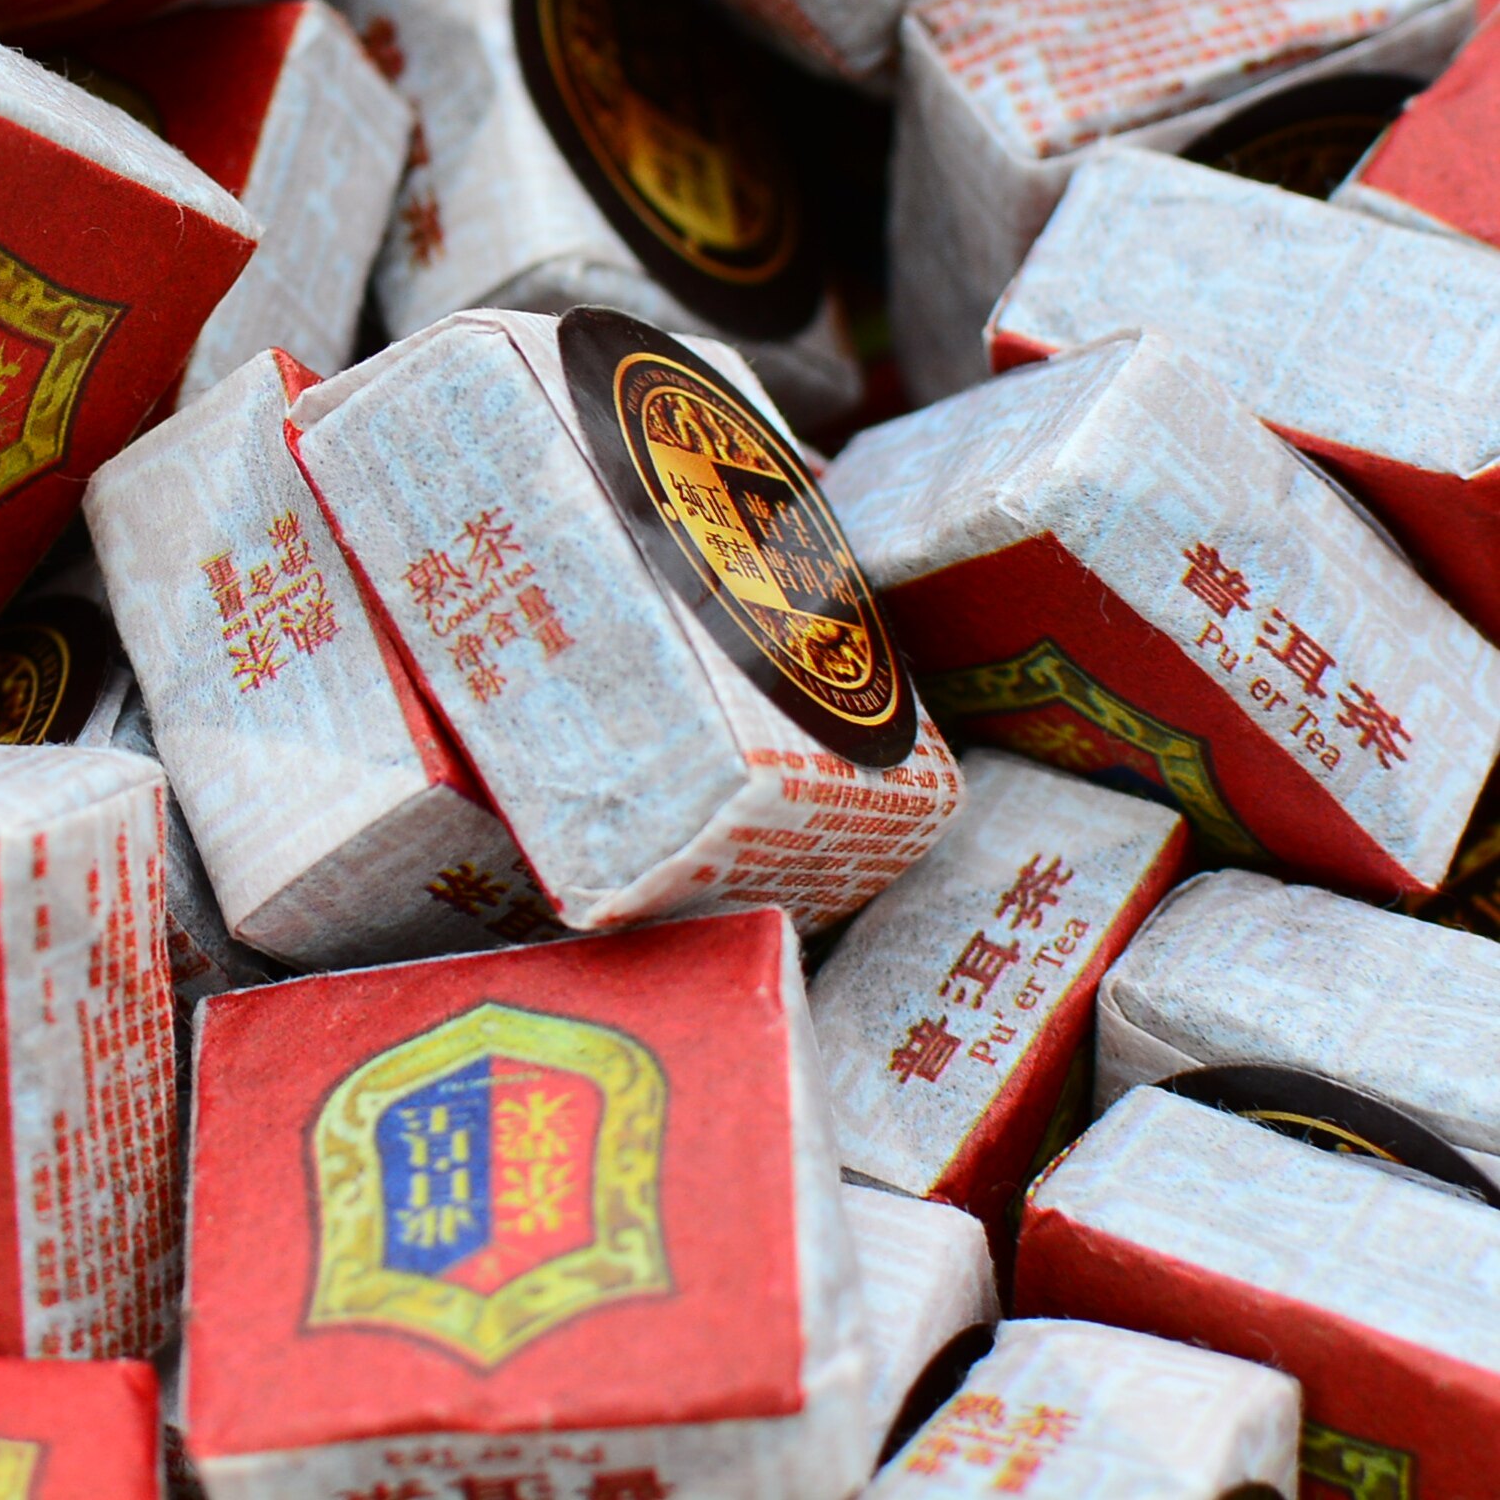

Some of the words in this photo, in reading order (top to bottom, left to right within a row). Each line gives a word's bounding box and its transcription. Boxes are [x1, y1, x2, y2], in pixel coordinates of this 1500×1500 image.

[253, 568, 326, 627] Cooked
[402, 506, 523, 621] 熟茶
[431, 577, 503, 638] Cooked
[504, 561, 536, 590] tea
[221, 611, 251, 640] tea
[228, 597, 341, 693] 熟茶
[1181, 541, 1413, 770] 普洱茶
[1289, 703, 1342, 771] Tea
[887, 852, 1075, 1084] 普洱茶
[1030, 916, 1091, 970] Tea
